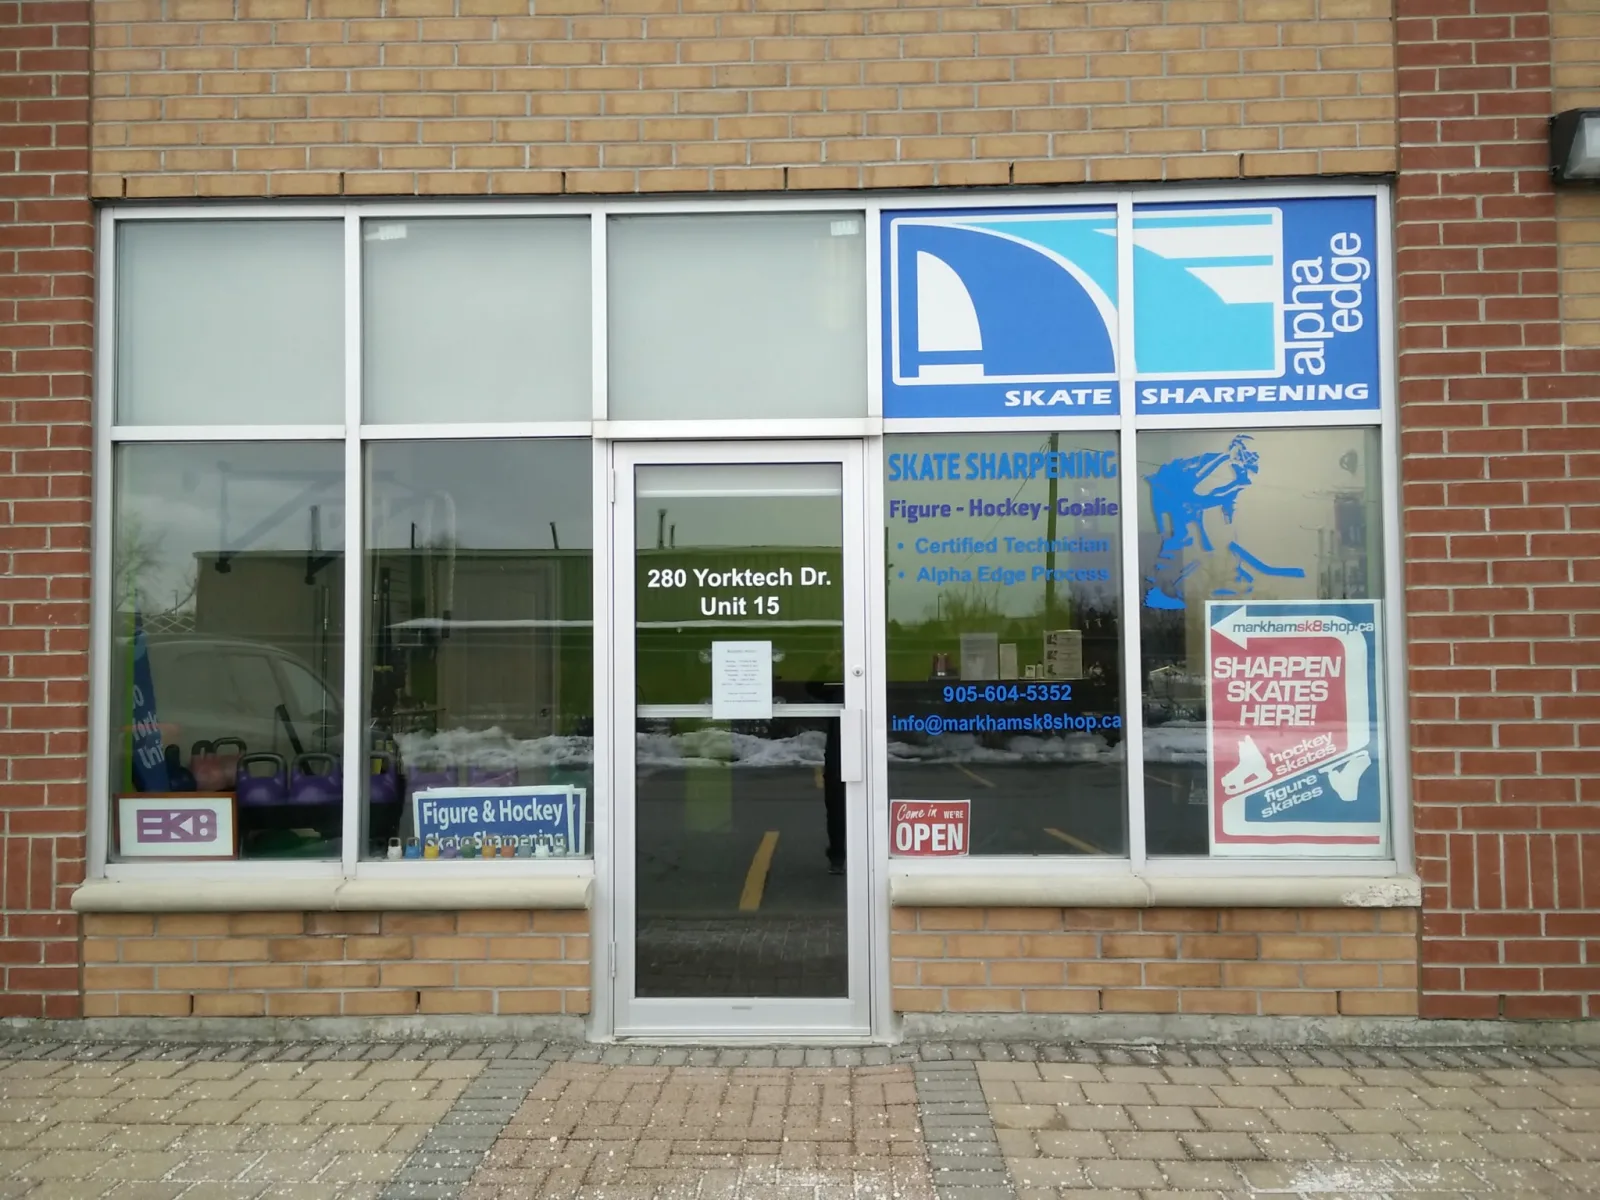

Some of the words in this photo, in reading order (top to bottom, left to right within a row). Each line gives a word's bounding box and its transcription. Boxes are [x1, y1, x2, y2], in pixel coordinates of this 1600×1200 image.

[1330, 232, 1370, 332] edge
[1284, 256, 1333, 375] alpha
[1005, 388, 1112, 407] SKATE
[1141, 383, 1369, 405] SHARPENING
[888, 452, 961, 481] SKATE
[966, 450, 1118, 480] SHARPENING
[889, 499, 951, 523] Figure
[969, 498, 1041, 520] Hockey
[1057, 498, 1118, 516] Goalie
[915, 537, 998, 554] Certified
[1004, 536, 1110, 553] Technician
[647, 569, 687, 588] 280
[693, 567, 793, 587] Yorktech
[800, 567, 831, 586] Dr.
[916, 566, 972, 585] Alpha
[978, 566, 1027, 585] Edge
[1032, 565, 1110, 582] Process
[700, 596, 747, 616] Unit
[754, 596, 780, 615] 15
[1232, 620, 1375, 635] markhamsk8shop.ca
[1214, 656, 1342, 678] SHARPEN
[943, 684, 1072, 703] 905-604-5352
[1227, 680, 1328, 702] SKATES
[892, 713, 1122, 735] info@markhamsk8shop.ca
[1239, 704, 1317, 726] HERE!
[1269, 732, 1332, 765] hockey
[1275, 743, 1337, 776] skates
[1263, 774, 1317, 803] figure
[422, 802, 478, 830] Figure
[482, 800, 496, 823] &
[499, 797, 564, 826] Hockey
[896, 803, 925, 822] Come
[927, 804, 938, 818] in
[943, 810, 964, 819] WE'RE
[1261, 786, 1323, 818] skates
[895, 822, 964, 851] OPEN
